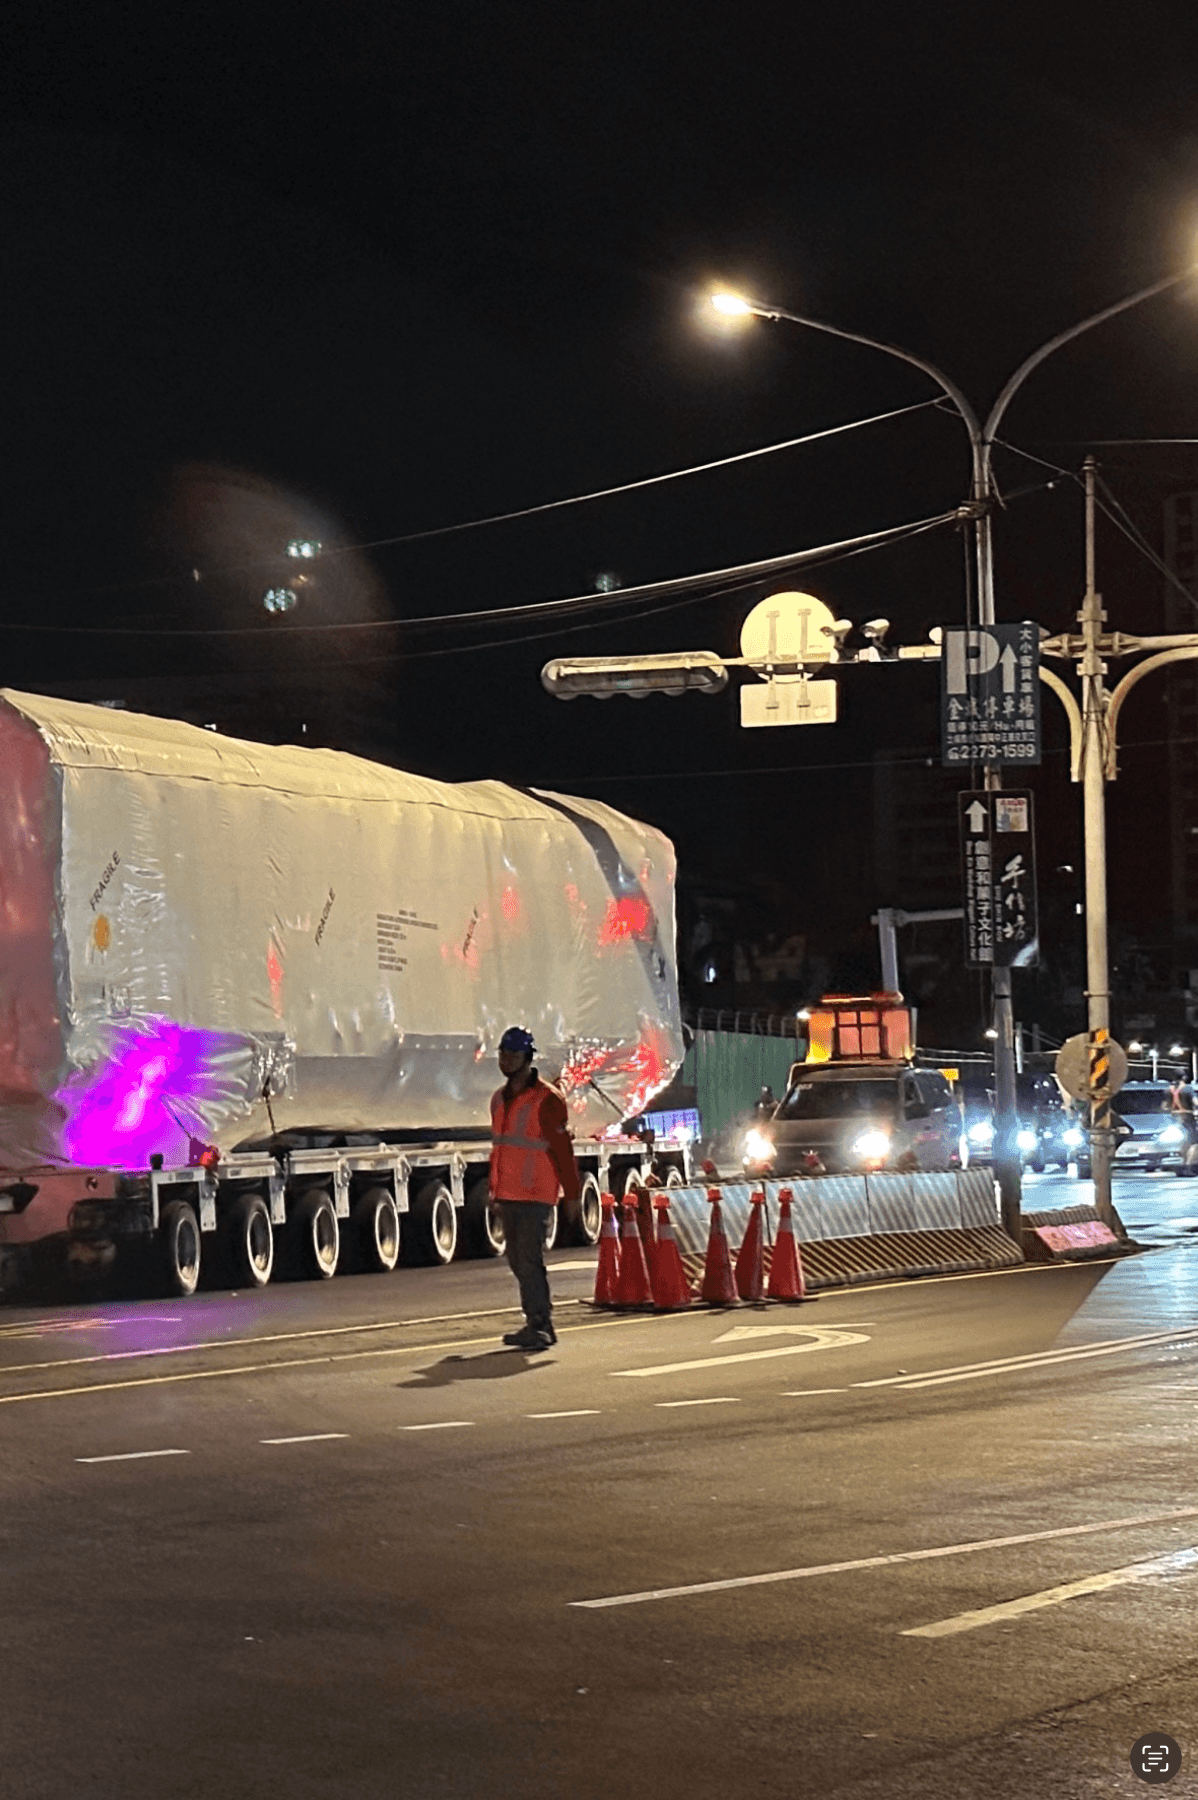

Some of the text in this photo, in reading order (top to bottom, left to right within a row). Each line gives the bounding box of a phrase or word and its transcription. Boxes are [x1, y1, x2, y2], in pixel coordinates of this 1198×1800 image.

[946, 630, 1000, 694] P
[961, 743, 1036, 759] 2273-1599
[89, 850, 121, 912] FRAGILE
